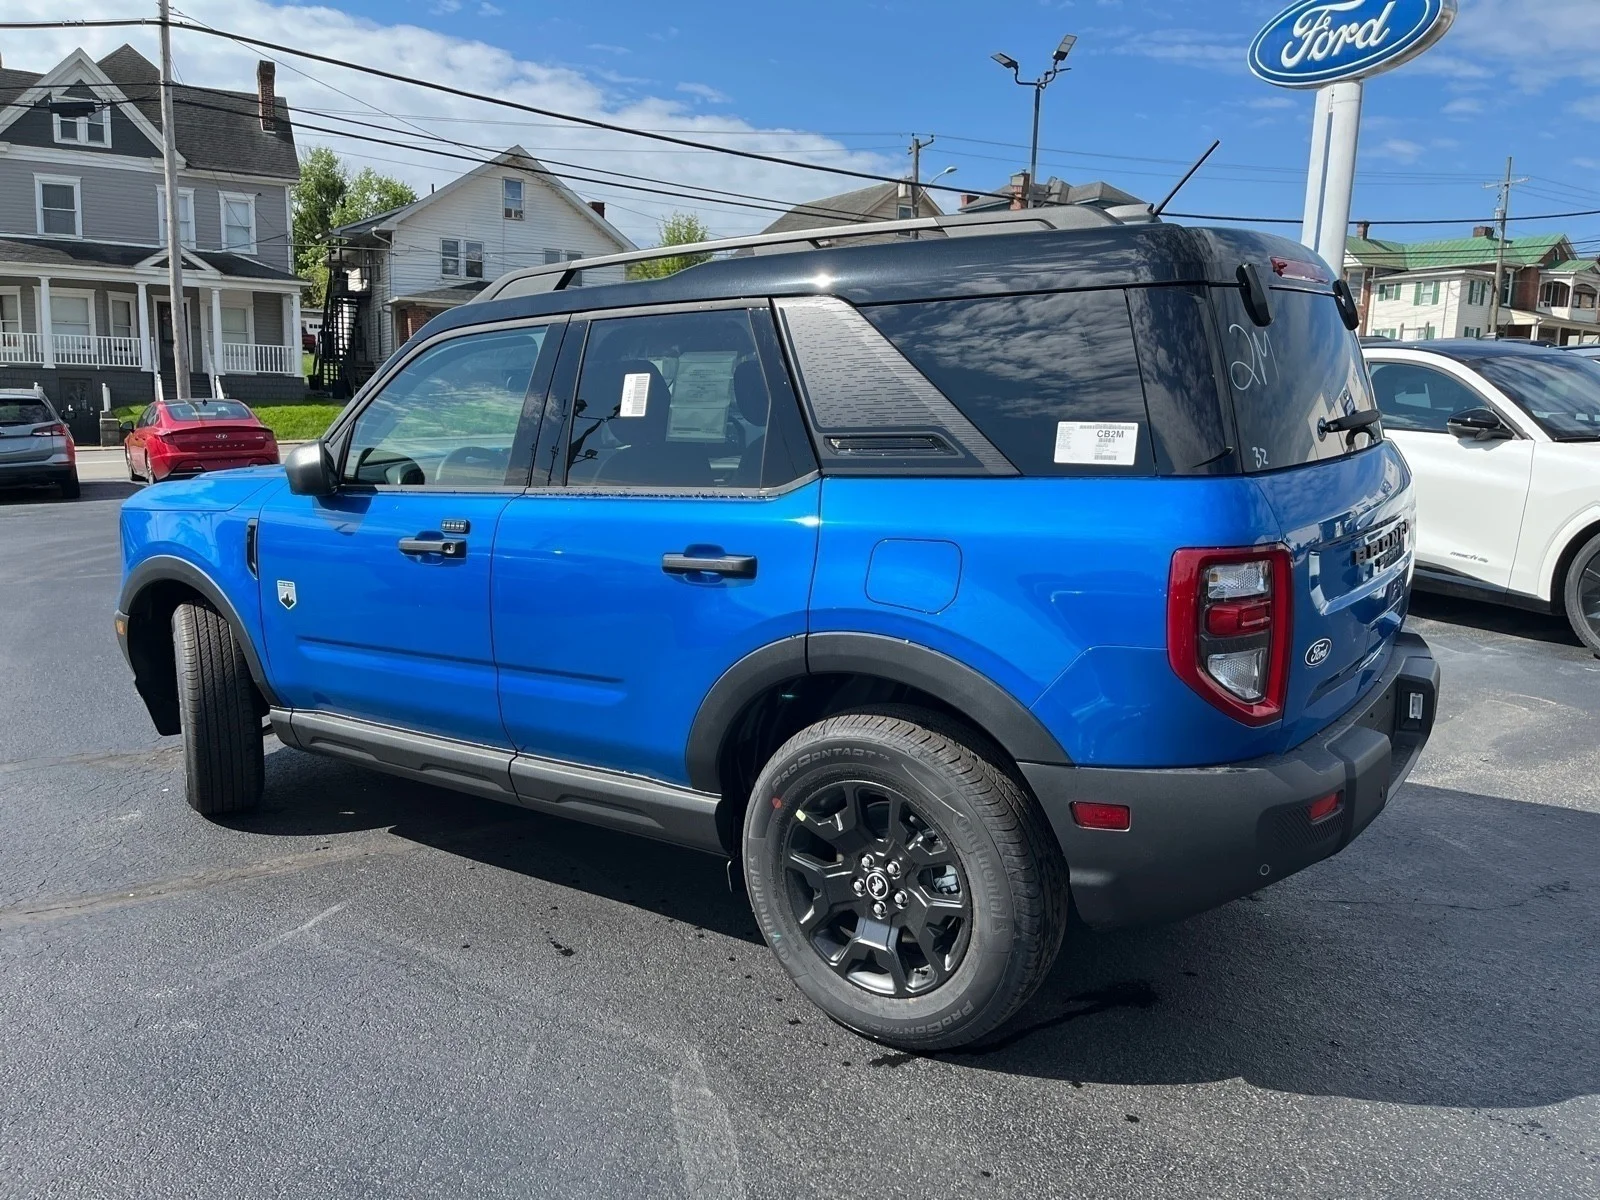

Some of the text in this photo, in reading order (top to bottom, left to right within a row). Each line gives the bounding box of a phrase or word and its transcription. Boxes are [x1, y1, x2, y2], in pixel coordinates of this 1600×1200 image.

[1281, 0, 1396, 68] Ford
[1229, 323, 1280, 391] 2M
[1096, 429, 1124, 438] CB2M
[1310, 642, 1329, 662] Ford
